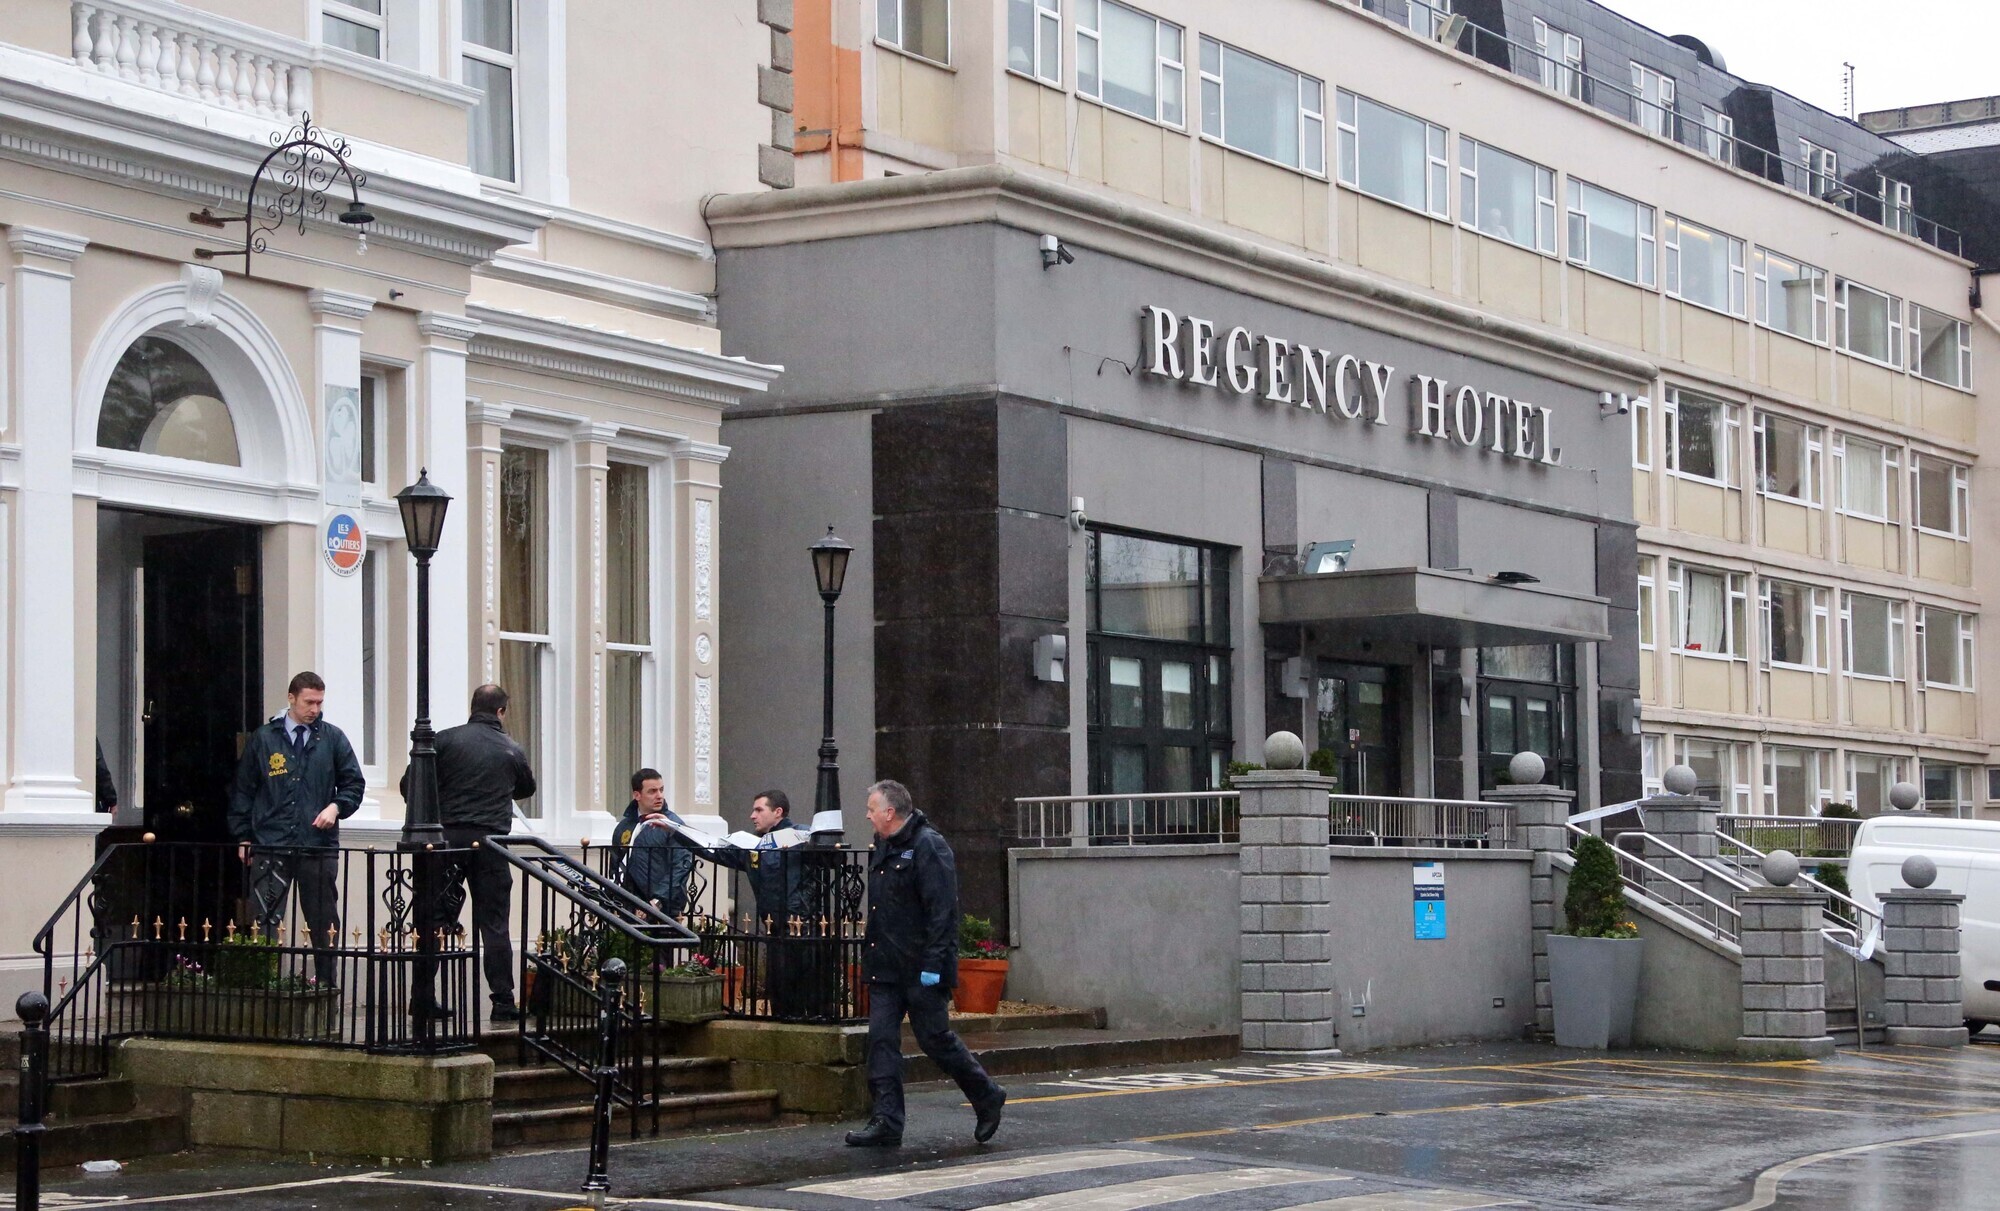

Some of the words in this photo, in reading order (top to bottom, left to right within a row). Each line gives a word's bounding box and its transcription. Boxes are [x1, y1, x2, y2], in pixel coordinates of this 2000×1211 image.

[1142, 305, 1395, 426] REGENCY
[1412, 374, 1562, 466] HOTEL
[337, 523, 350, 535] LES
[328, 536, 361, 550] ROUTIERS
[1036, 1072, 1240, 1090] KEEP
